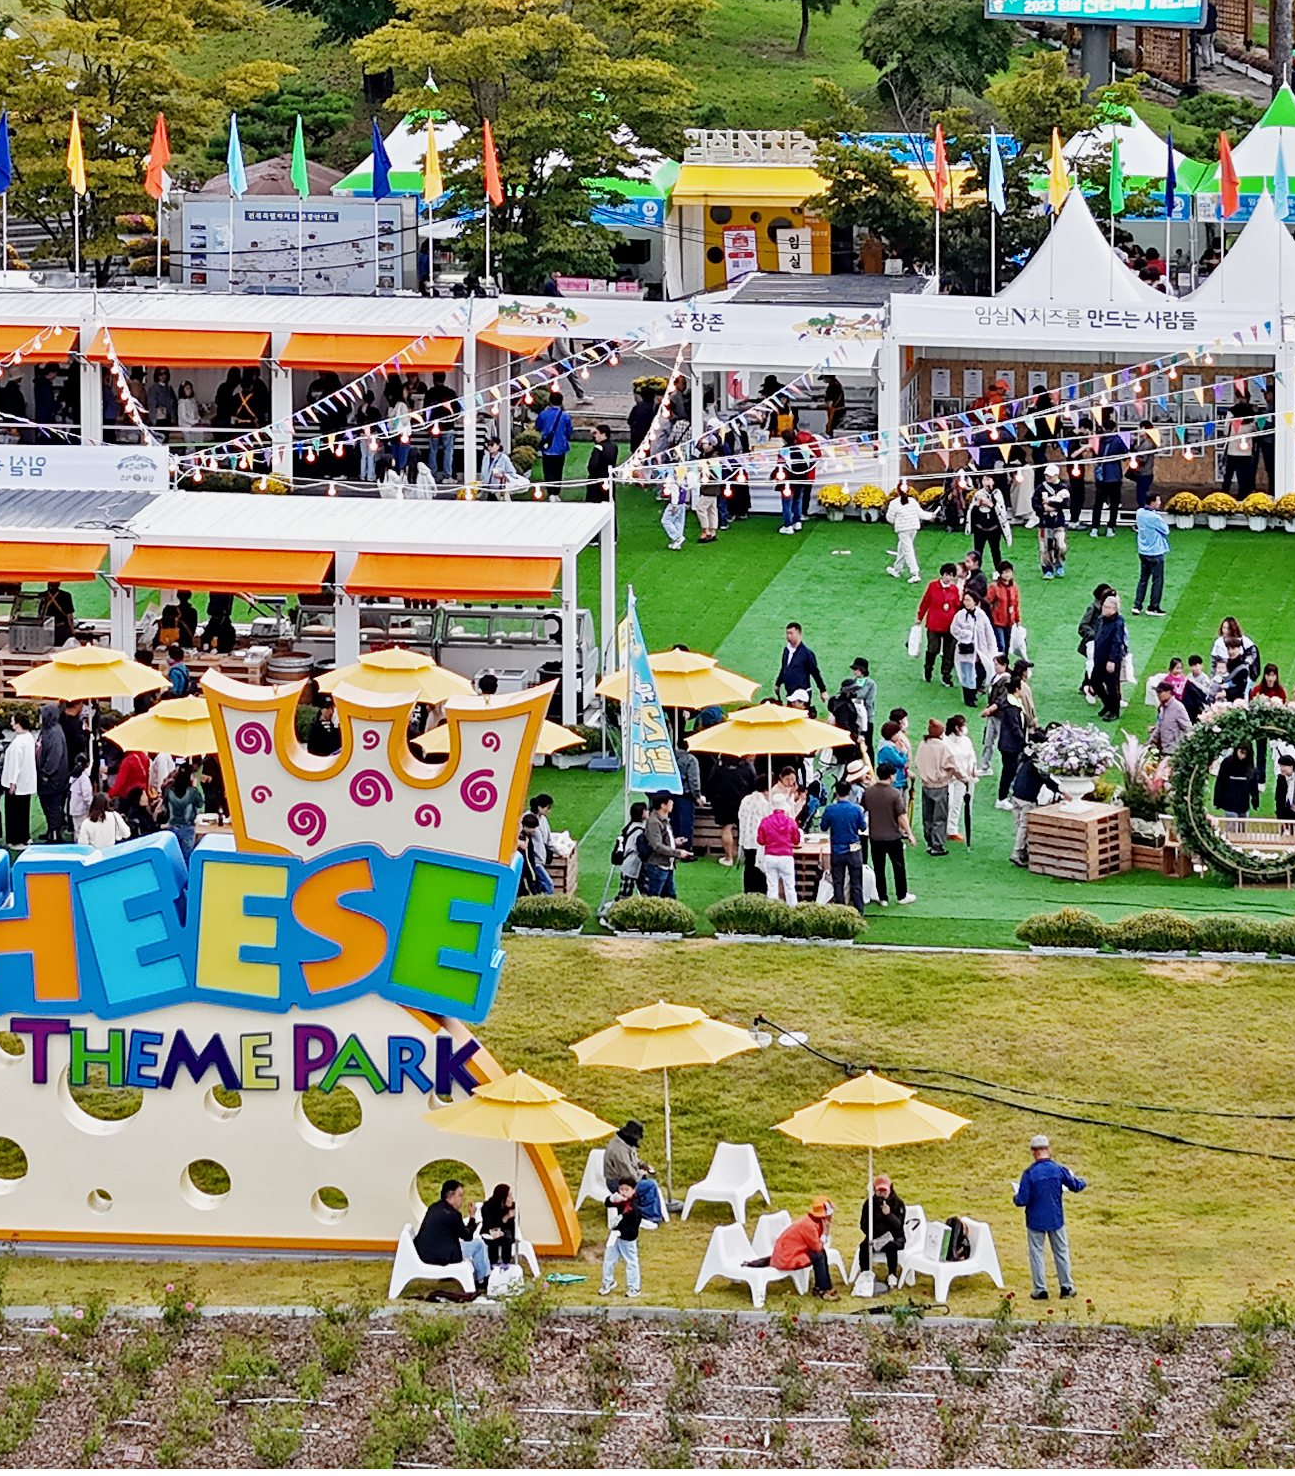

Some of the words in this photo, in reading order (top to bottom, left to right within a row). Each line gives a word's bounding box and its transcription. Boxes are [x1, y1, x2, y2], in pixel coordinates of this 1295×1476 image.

[1023, 0, 1056, 14] 2023
[974, 306, 1083, 327] 임실N치즈를
[1086, 309, 1140, 329] 만드는
[1143, 310, 1198, 331] 사람들
[9, 1016, 280, 1092] THEME
[291, 1022, 482, 1097] PARK
